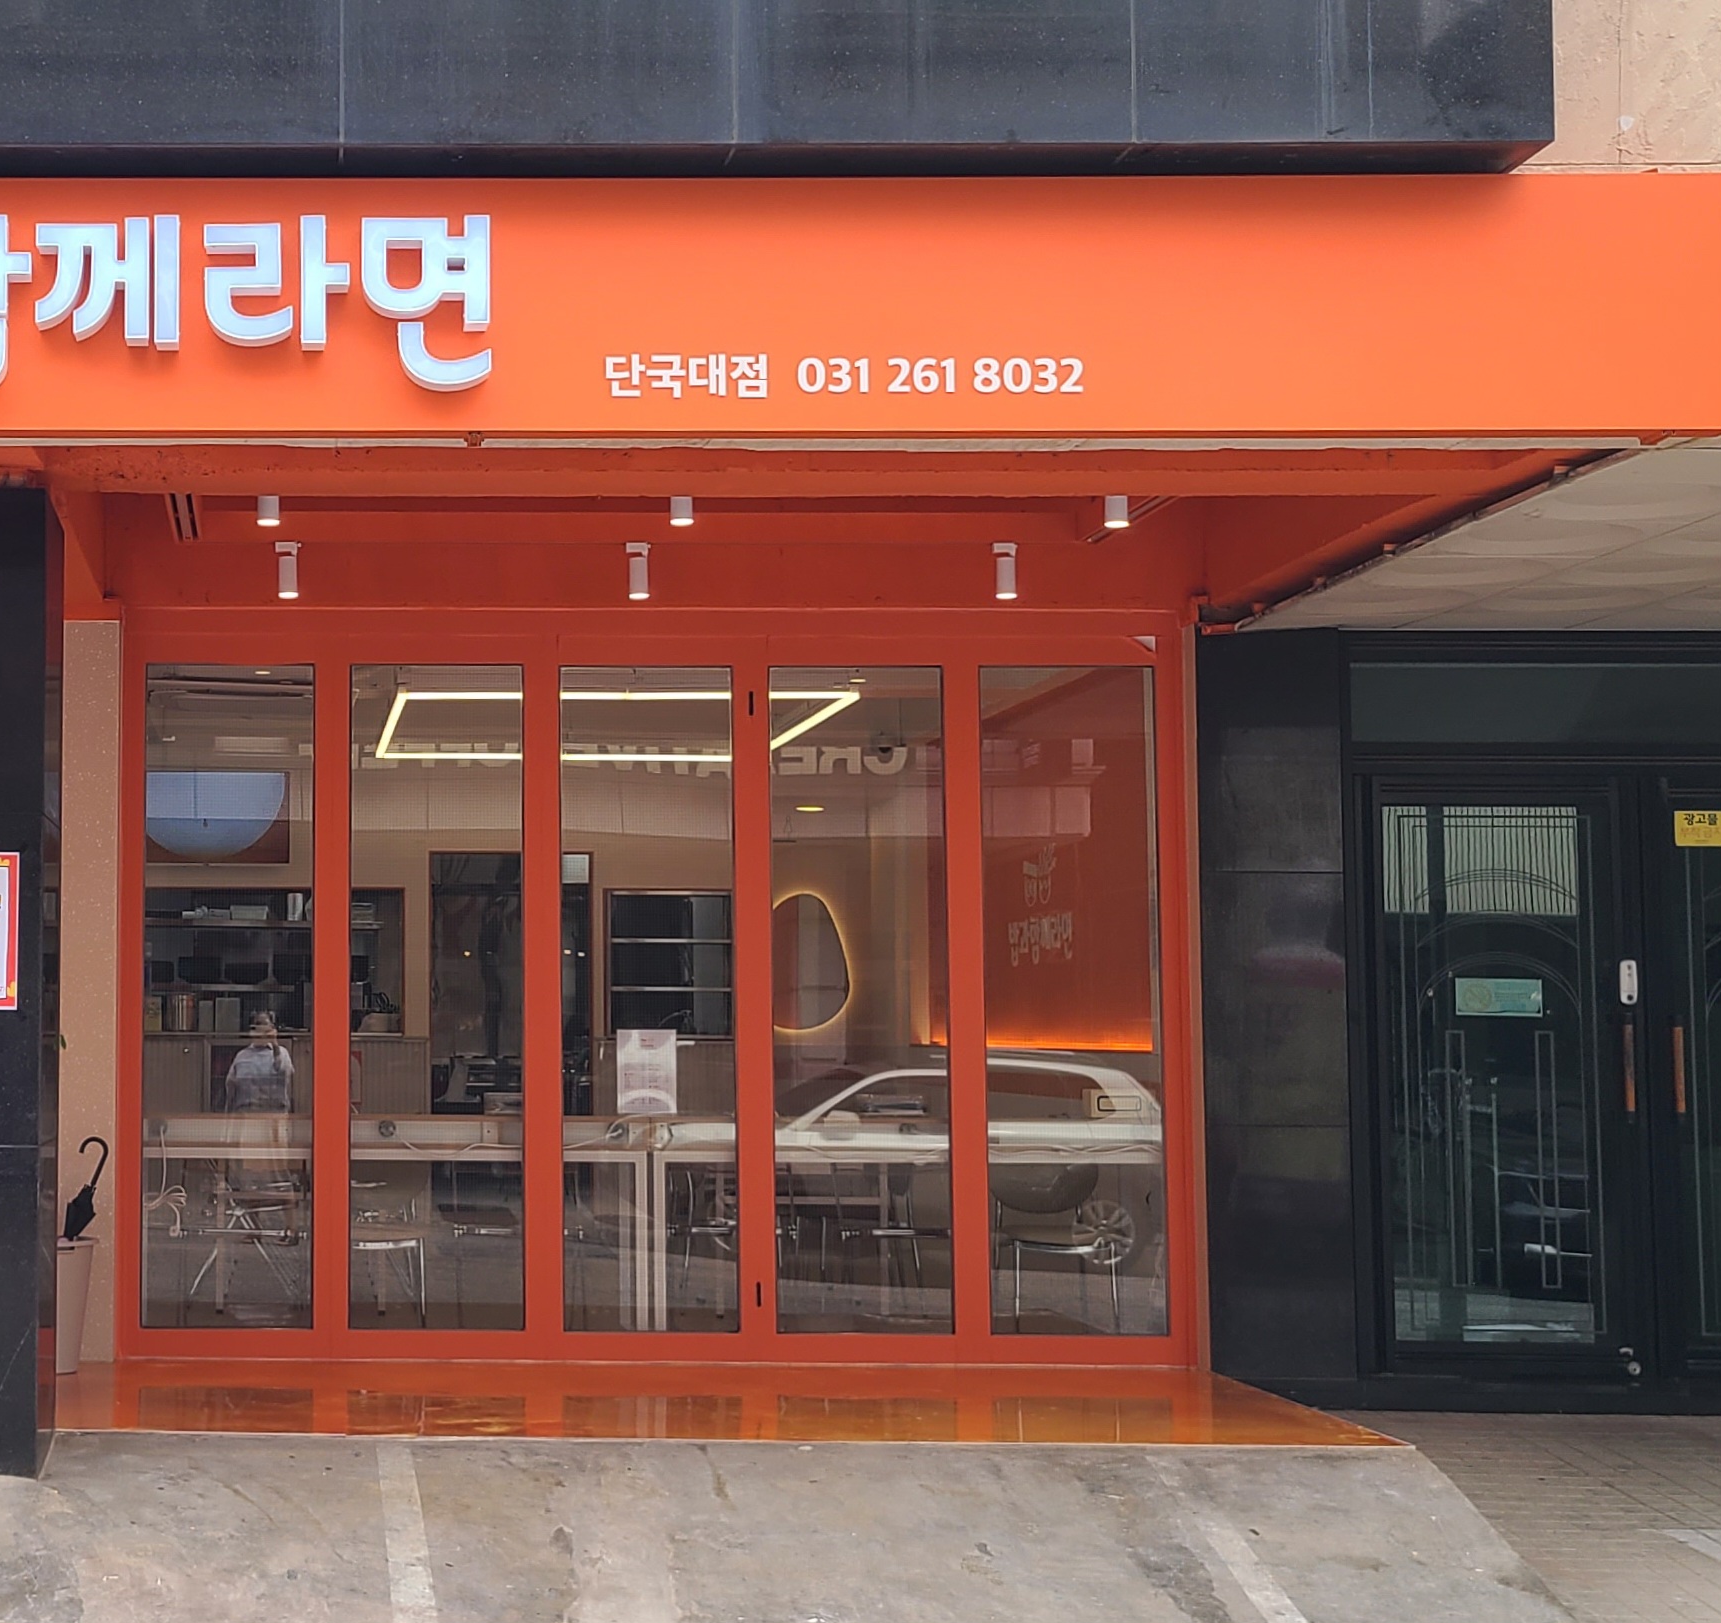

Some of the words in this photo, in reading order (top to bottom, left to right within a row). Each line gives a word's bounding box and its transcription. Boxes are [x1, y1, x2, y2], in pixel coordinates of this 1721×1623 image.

[605, 354, 769, 398] 단국대점
[797, 357, 870, 393] 031
[887, 357, 957, 393] 261
[973, 357, 1084, 393] 8032
[1683, 813, 1718, 826] 광고물
